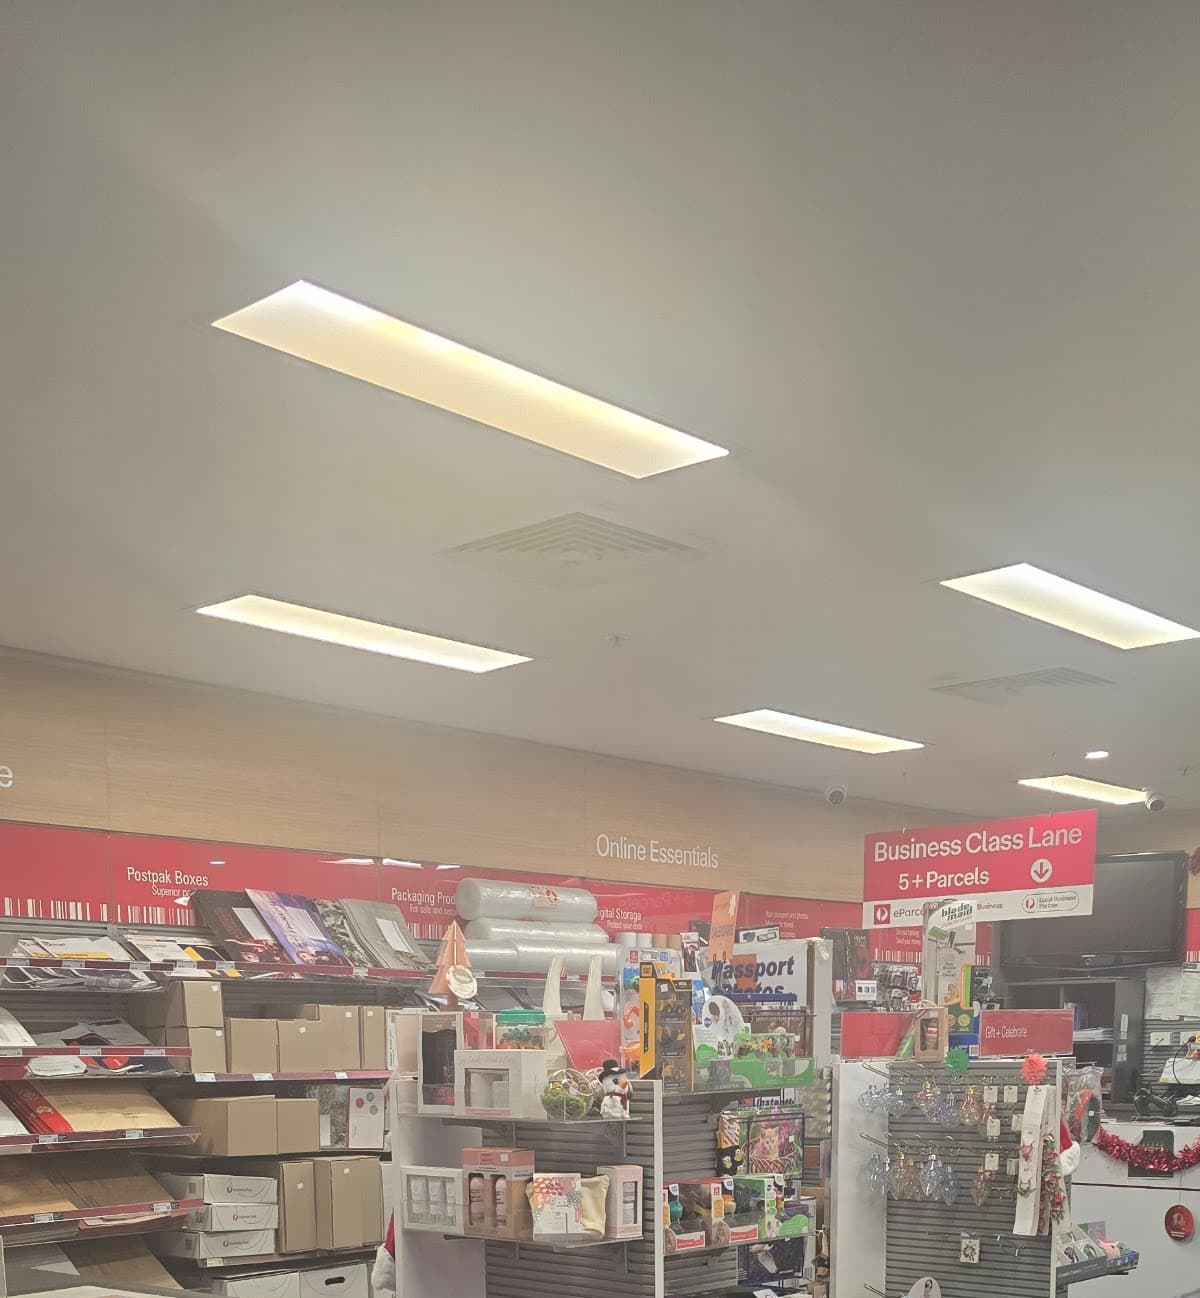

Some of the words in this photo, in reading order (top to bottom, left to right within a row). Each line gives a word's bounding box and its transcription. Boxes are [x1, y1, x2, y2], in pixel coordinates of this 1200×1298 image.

[596, 833, 646, 861] Online
[650, 840, 719, 869] Essentials
[874, 838, 962, 863] Business
[965, 830, 1024, 854] Class
[1028, 826, 1083, 849] Lane
[127, 866, 172, 887] Postpak
[175, 870, 209, 887] Boxes
[926, 867, 990, 889] Parcels
[151, 885, 181, 898] Superior
[391, 887, 435, 906] Packaging
[437, 891, 456, 905] Prod
[409, 903, 419, 913] For
[600, 907, 615, 920] gital
[616, 907, 642, 921] Storage
[893, 907, 923, 919] eParc
[941, 902, 970, 917] blade
[947, 905, 973, 921] maid
[711, 955, 795, 982] Passport
[985, 1026, 996, 1039] Gift
[1001, 1026, 1028, 1039] Celebrate
